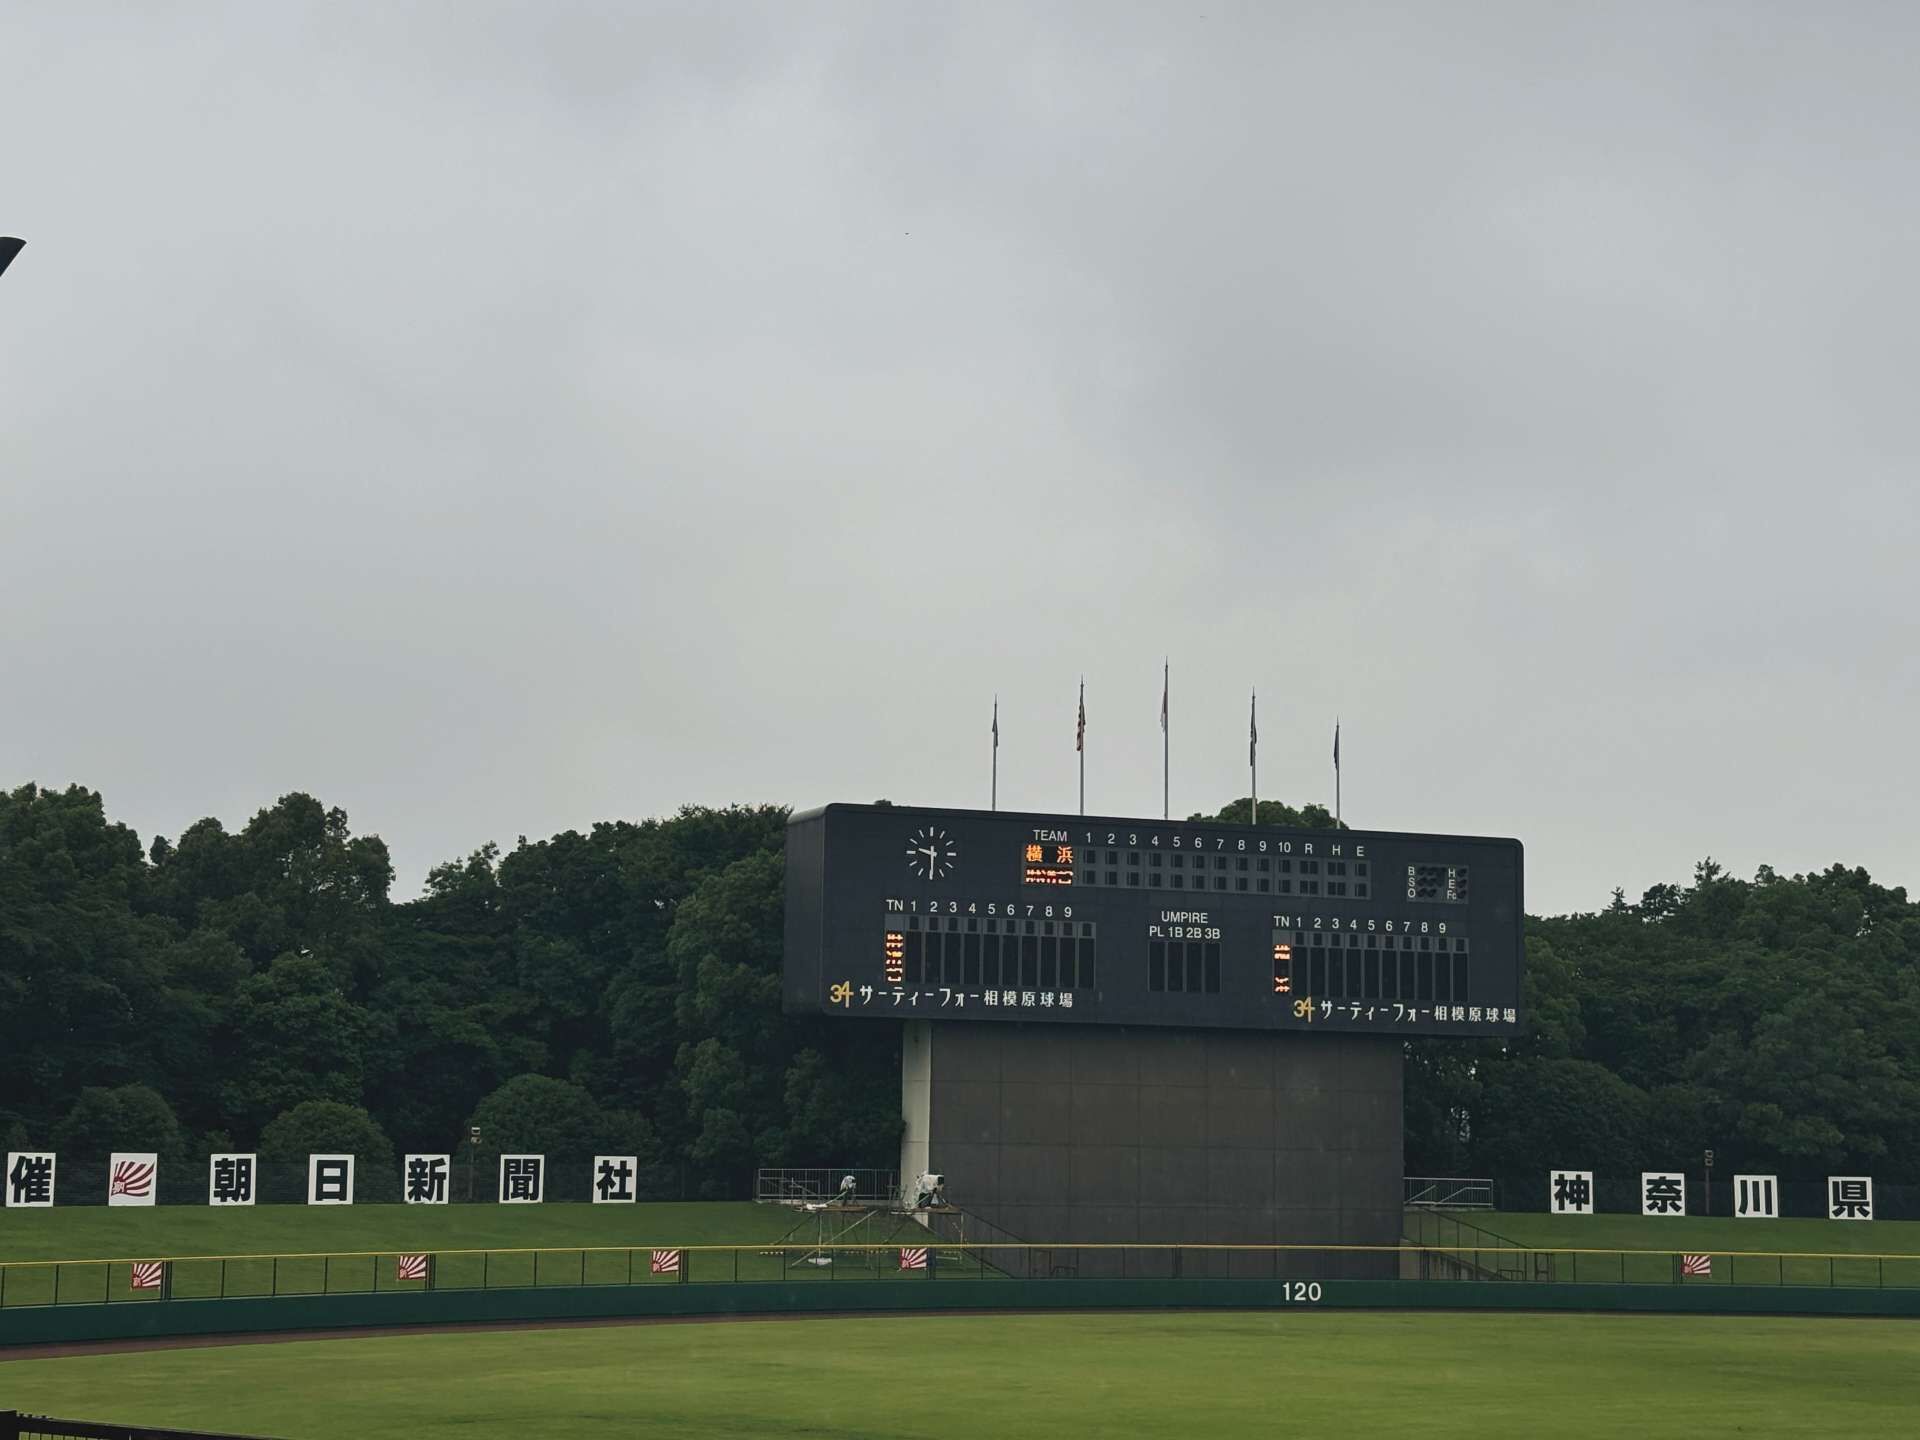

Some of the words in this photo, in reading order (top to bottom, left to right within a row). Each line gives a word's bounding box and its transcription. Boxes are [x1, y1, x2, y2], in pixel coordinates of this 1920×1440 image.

[1033, 829, 1067, 842] TEAM
[1085, 832, 1092, 843] 1
[1107, 833, 1115, 845] 2
[1129, 834, 1137, 845] 3
[1151, 835, 1159, 846] 4
[1173, 837, 1181, 847] 5
[1194, 837, 1202, 848] 6
[1217, 839, 1224, 849] 7
[1238, 839, 1246, 850] 8
[1259, 840, 1267, 851] 9
[1278, 842, 1291, 853] 10
[1304, 843, 1313, 854] R
[1332, 845, 1341, 856] H
[1356, 846, 1364, 857] E
[1408, 866, 1415, 876] B
[1448, 868, 1456, 878] H
[1408, 877, 1416, 887] S
[1448, 879, 1456, 889] E
[1408, 888, 1416, 898] O
[886, 899, 903, 911] TN
[911, 901, 916, 911] 1
[930, 901, 938, 912] 2
[950, 902, 957, 913] 3
[968, 903, 976, 914] 4
[988, 904, 996, 914] 5
[1007, 904, 1015, 915] 6
[1027, 906, 1034, 916] 7
[1045, 906, 1053, 917] 8
[1064, 907, 1072, 918] 9
[1161, 911, 1208, 924] UMPIRE
[1273, 916, 1290, 928] TN
[1296, 917, 1301, 928] 1
[1314, 917, 1321, 929] 2
[1332, 918, 1340, 929] 3
[1350, 920, 1357, 930] 4
[1368, 920, 1375, 931] 5
[1386, 921, 1393, 932] 6
[1403, 922, 1410, 932] 7
[1421, 922, 1429, 933] 8
[1439, 922, 1446, 934] 9
[1149, 925, 1165, 937] PL
[1168, 926, 1183, 938] 1B
[1186, 927, 1202, 939] 2B
[1204, 928, 1220, 939] 3B
[10, 1156, 52, 1203] 催
[1282, 1282, 1322, 1301] 120
